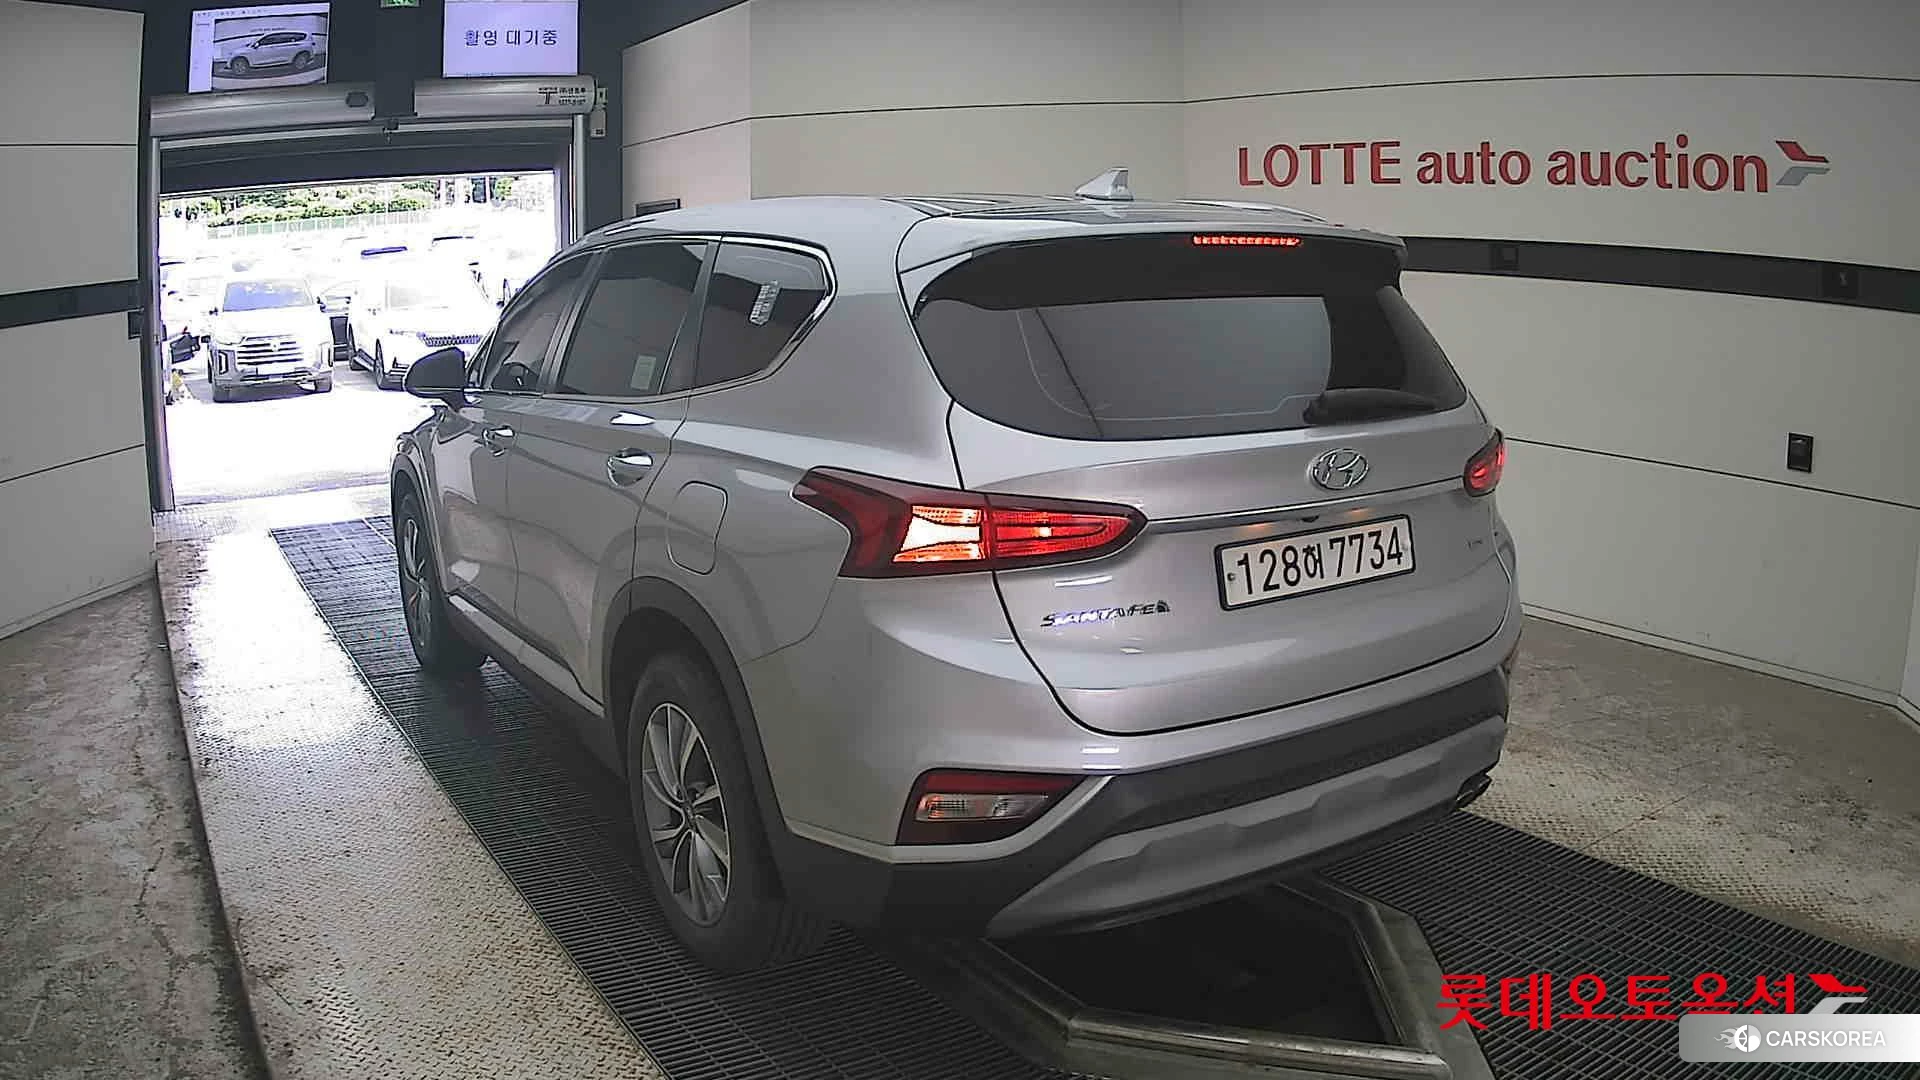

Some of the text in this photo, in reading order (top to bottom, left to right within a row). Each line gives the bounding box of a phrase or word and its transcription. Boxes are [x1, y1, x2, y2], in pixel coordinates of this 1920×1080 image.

[506, 29, 558, 46] 대기중
[1239, 133, 1769, 194] LOTTE auto auction
